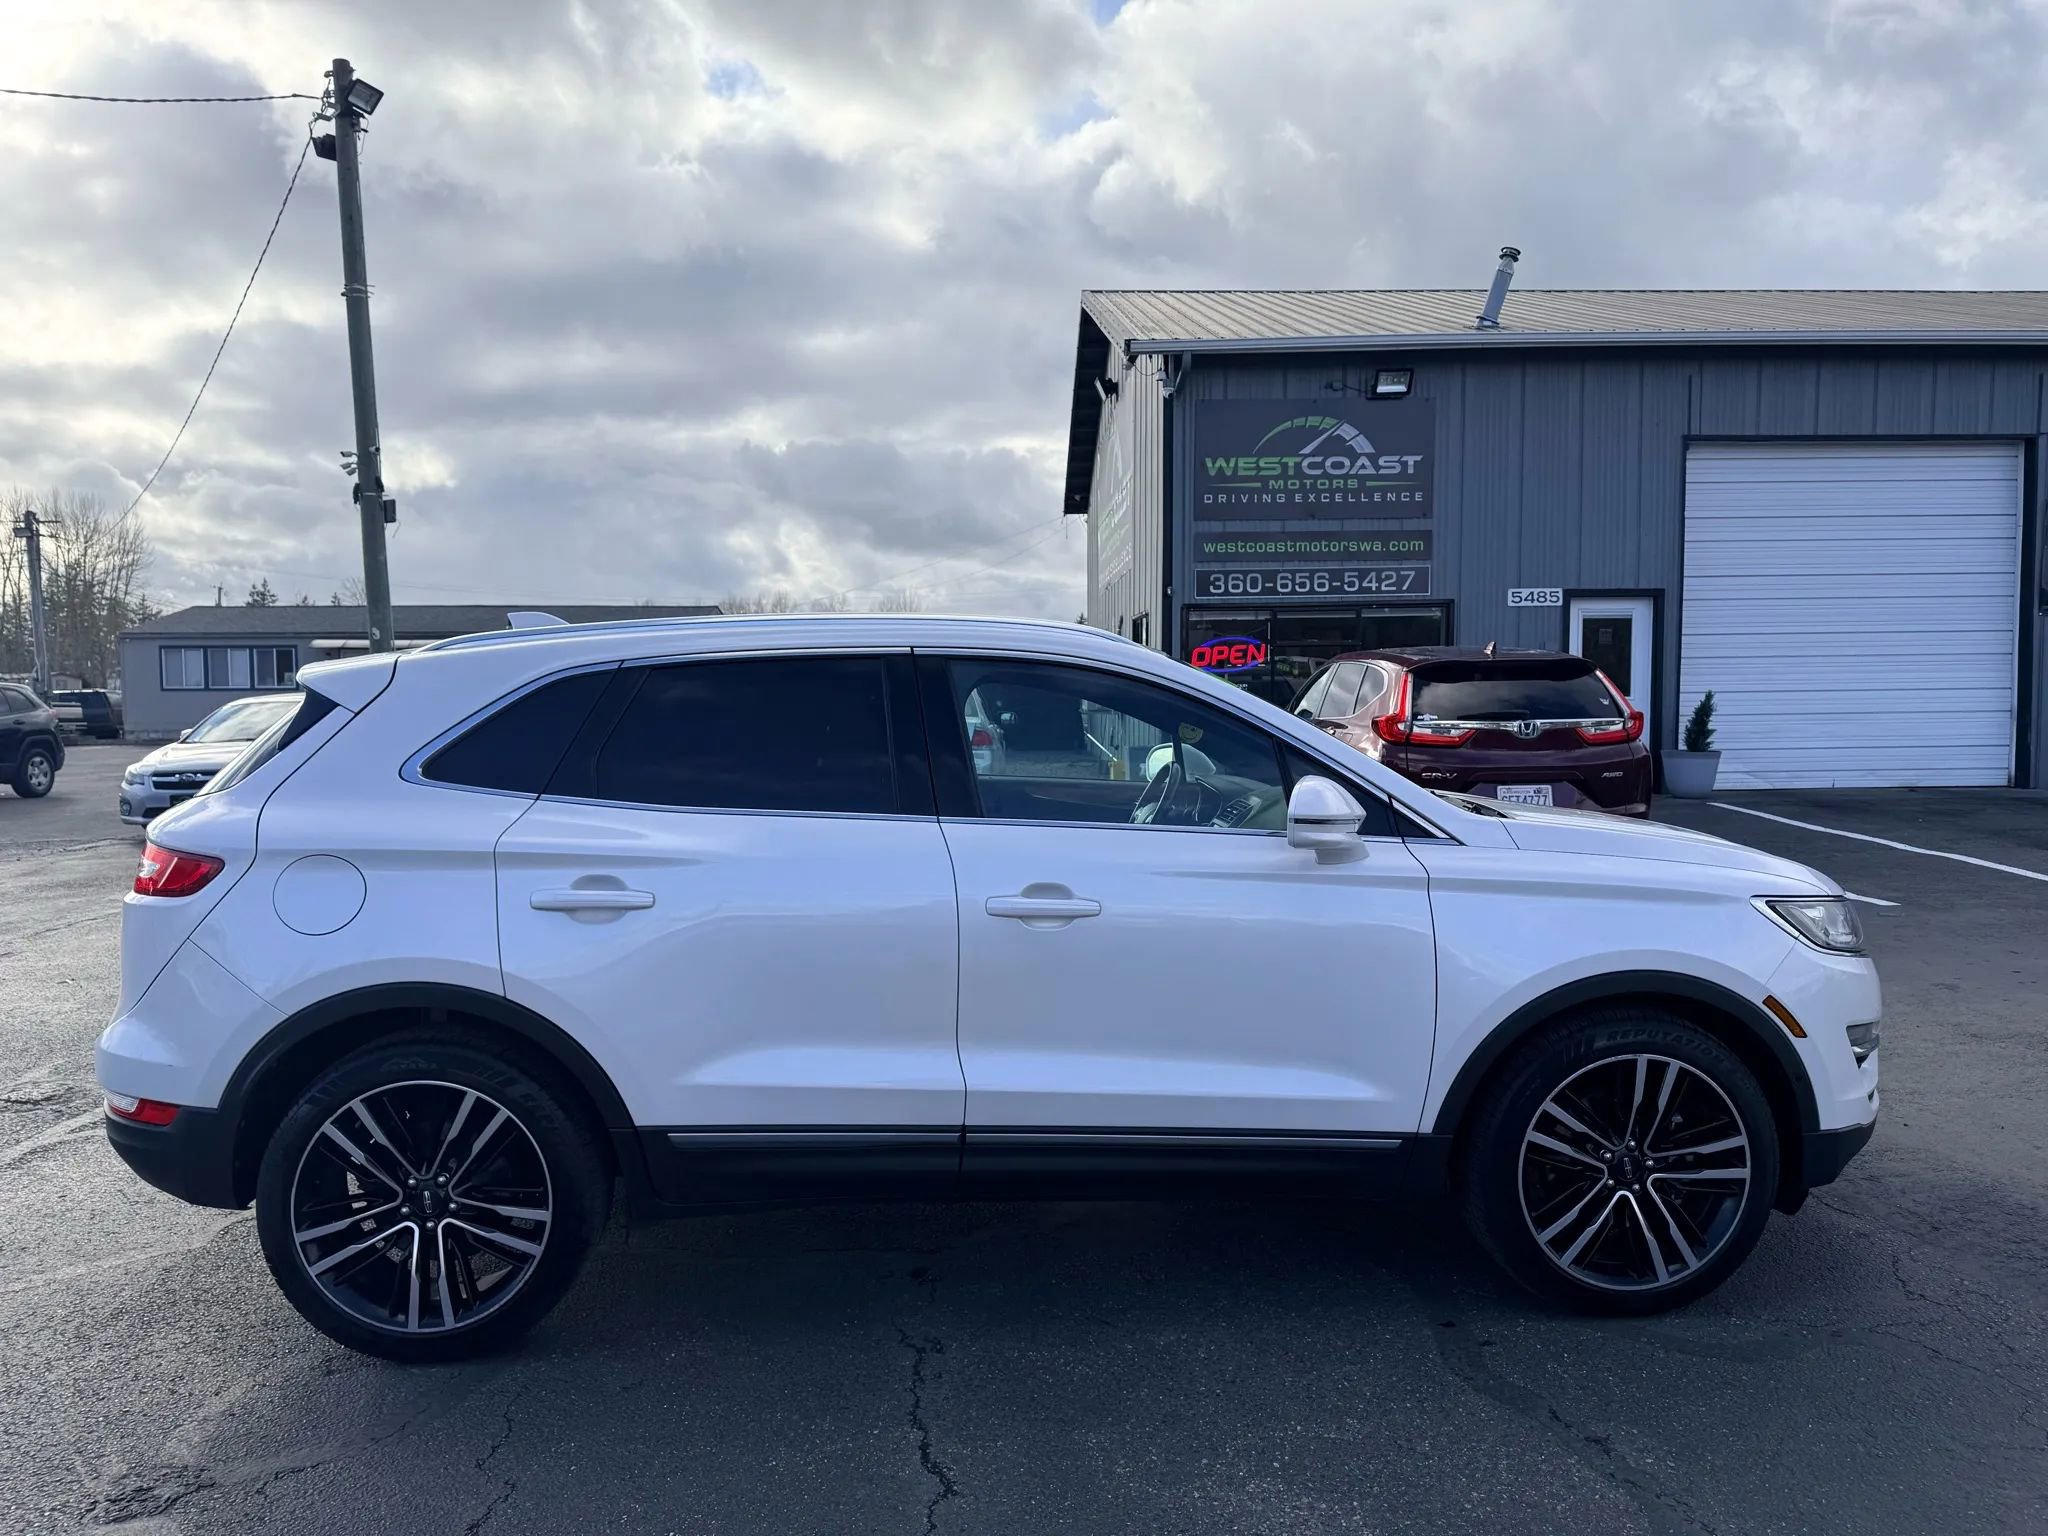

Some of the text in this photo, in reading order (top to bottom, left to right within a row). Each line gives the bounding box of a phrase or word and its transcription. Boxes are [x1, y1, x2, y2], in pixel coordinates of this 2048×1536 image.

[1204, 455, 1424, 476] WESTCOAST
[1268, 479, 1358, 489] MOTORS
[1204, 492, 1424, 503] DRIVING EXCELLENCE
[1203, 540, 1424, 553] westcoastmotorswa.com
[1209, 571, 1416, 594] 360-656-5427
[1510, 590, 1560, 604] 5485
[1191, 644, 1266, 667] OPEN
